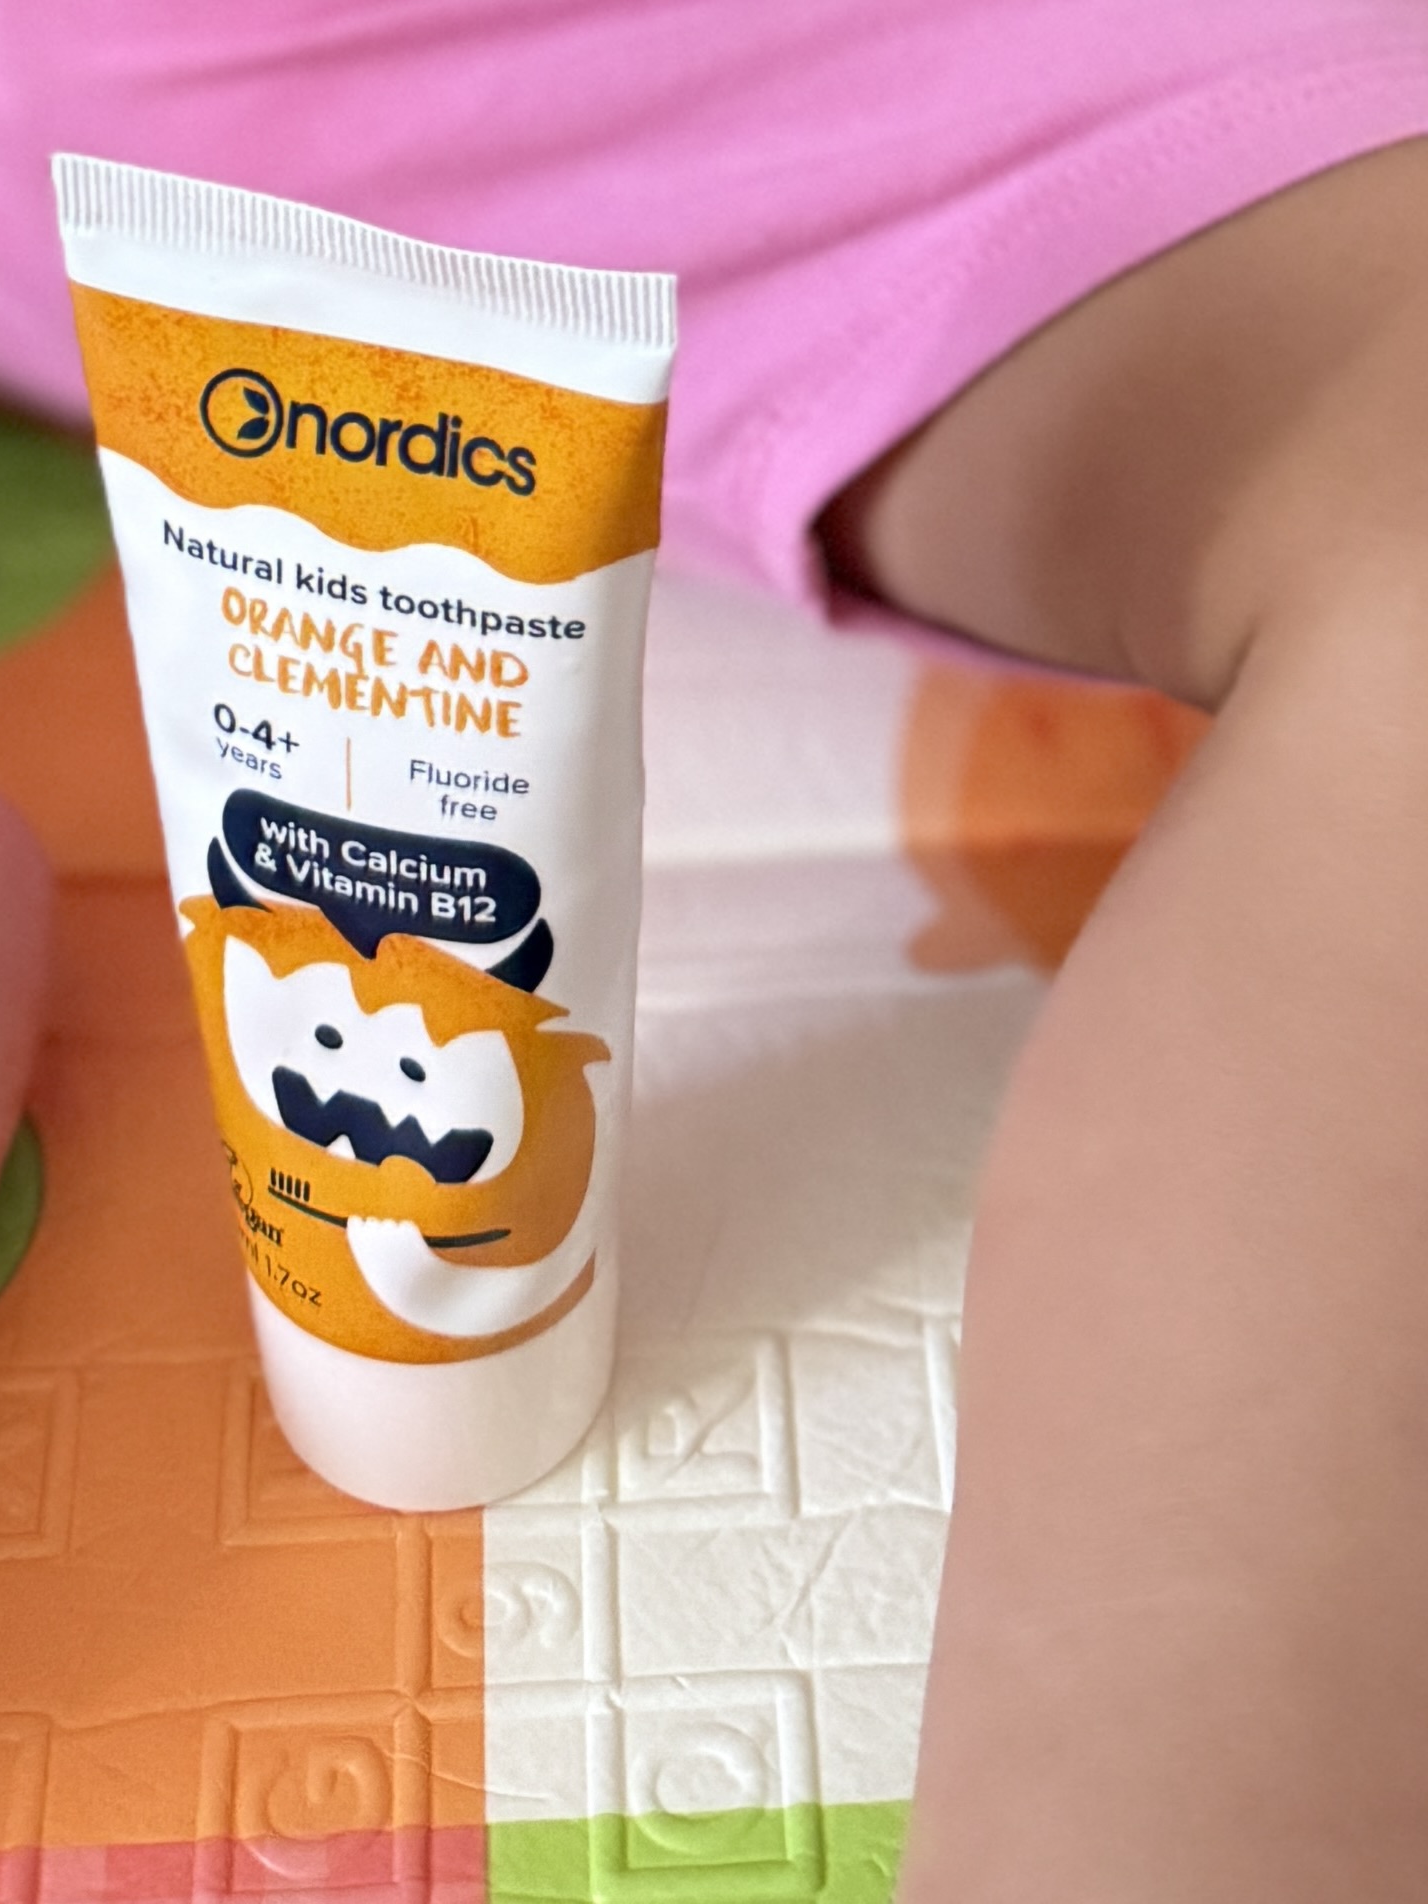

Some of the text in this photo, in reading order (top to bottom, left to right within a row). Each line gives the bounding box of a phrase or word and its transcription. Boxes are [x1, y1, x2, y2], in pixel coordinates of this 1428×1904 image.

[285, 399, 537, 496] nordics
[162, 519, 586, 641] Natural kids toothpaste
[221, 585, 529, 688] ORANGE AND
[228, 642, 522, 738] CLEMENTINE
[213, 703, 300, 754] 0-4+
[215, 737, 283, 780] years
[410, 759, 530, 795] Fluoride
[439, 794, 498, 821] free
[254, 843, 497, 923] & Vitamin B12
[260, 816, 487, 890] with Calcium
[264, 1254, 322, 1307] 1.7oz
